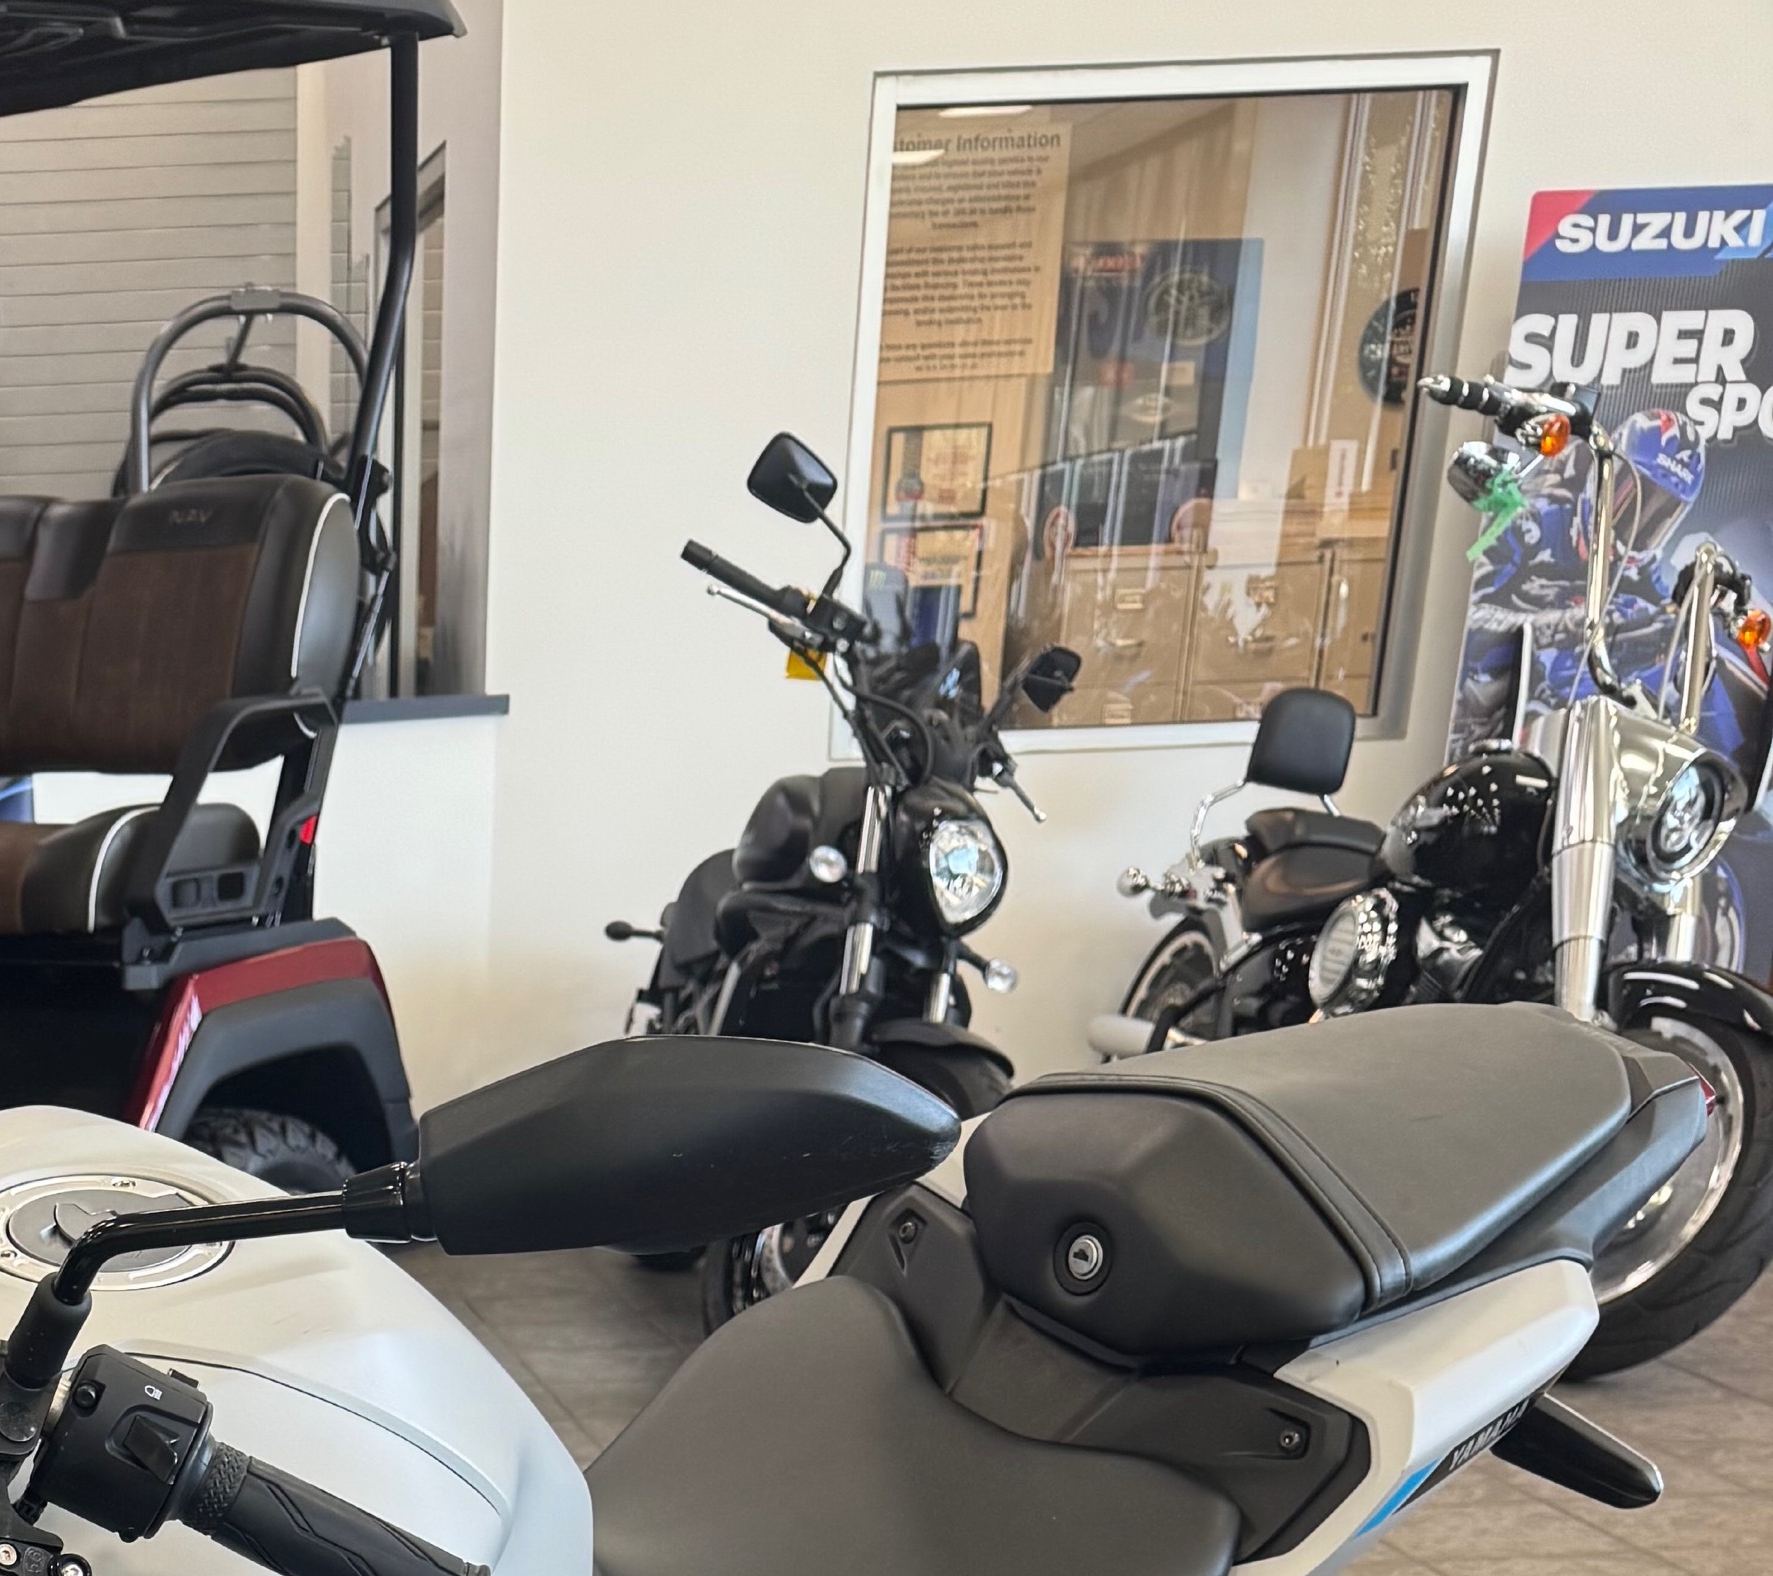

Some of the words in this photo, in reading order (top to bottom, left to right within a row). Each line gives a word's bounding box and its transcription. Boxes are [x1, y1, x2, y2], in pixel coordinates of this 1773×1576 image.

[956, 132, 1061, 152] Information
[1555, 209, 1767, 253] SUZUKI
[1503, 308, 1755, 388] SUPER
[1449, 1398, 1530, 1471] YAMAHA
